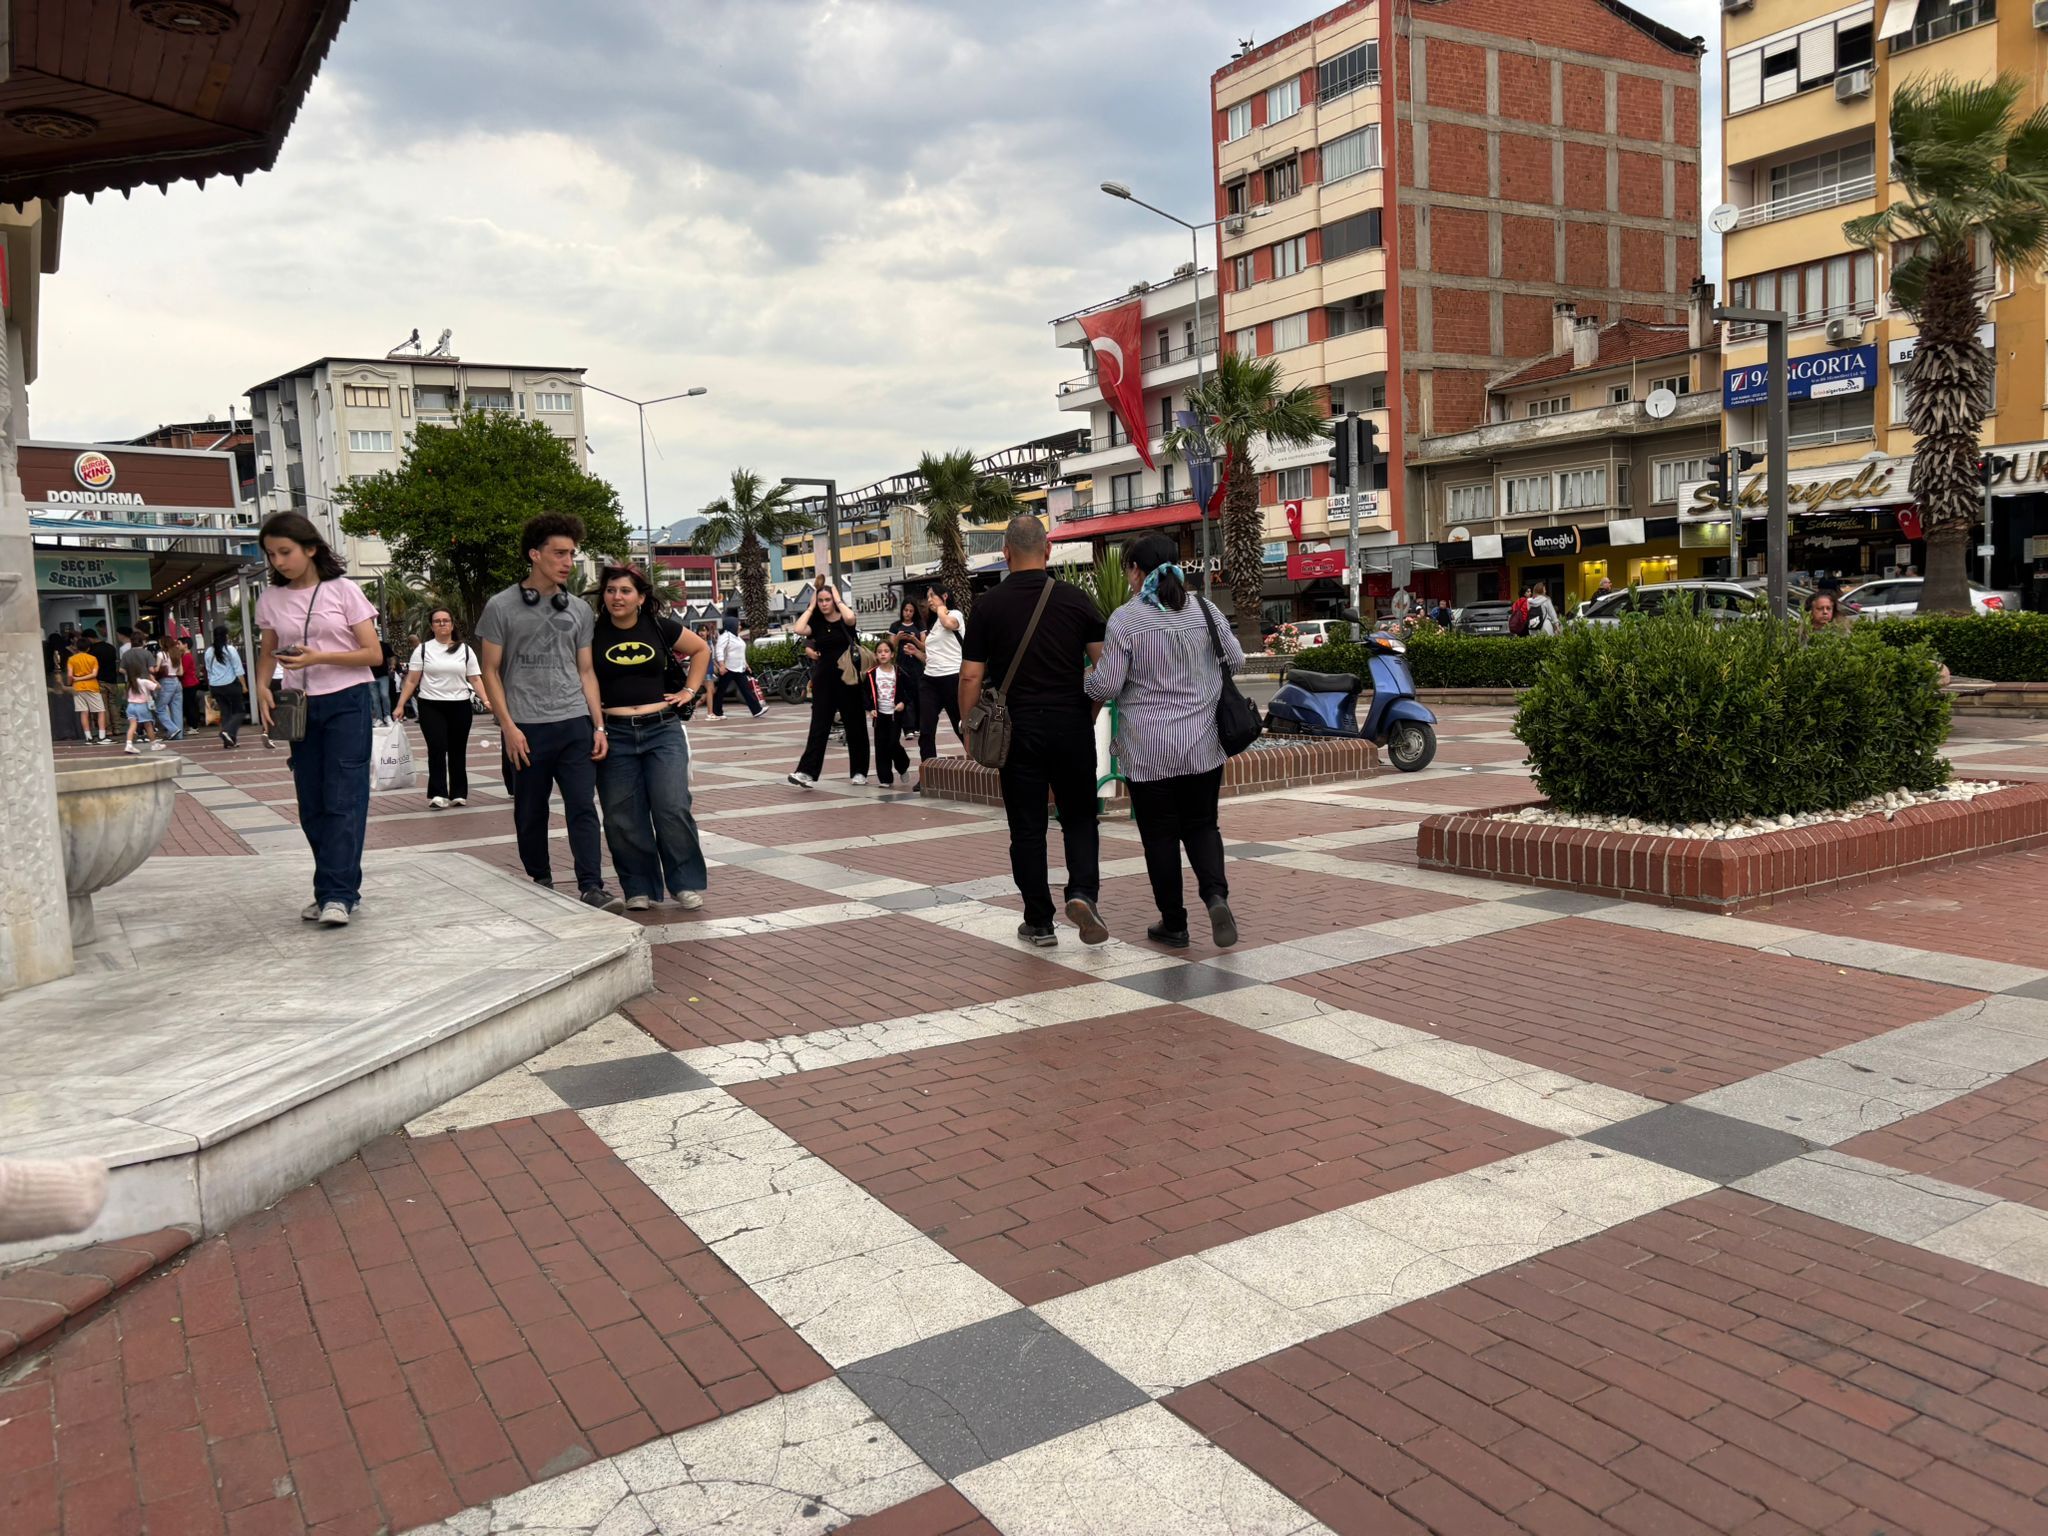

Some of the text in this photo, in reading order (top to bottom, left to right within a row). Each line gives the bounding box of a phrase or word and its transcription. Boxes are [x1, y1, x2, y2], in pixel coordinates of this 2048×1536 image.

[81, 459, 109, 473] BURGER
[83, 466, 111, 481] KING
[47, 490, 145, 505] DONDURMA
[1534, 533, 1574, 549] alimoğlu
[60, 560, 86, 575] SEÇ
[48, 571, 118, 588] SERİNLİK
